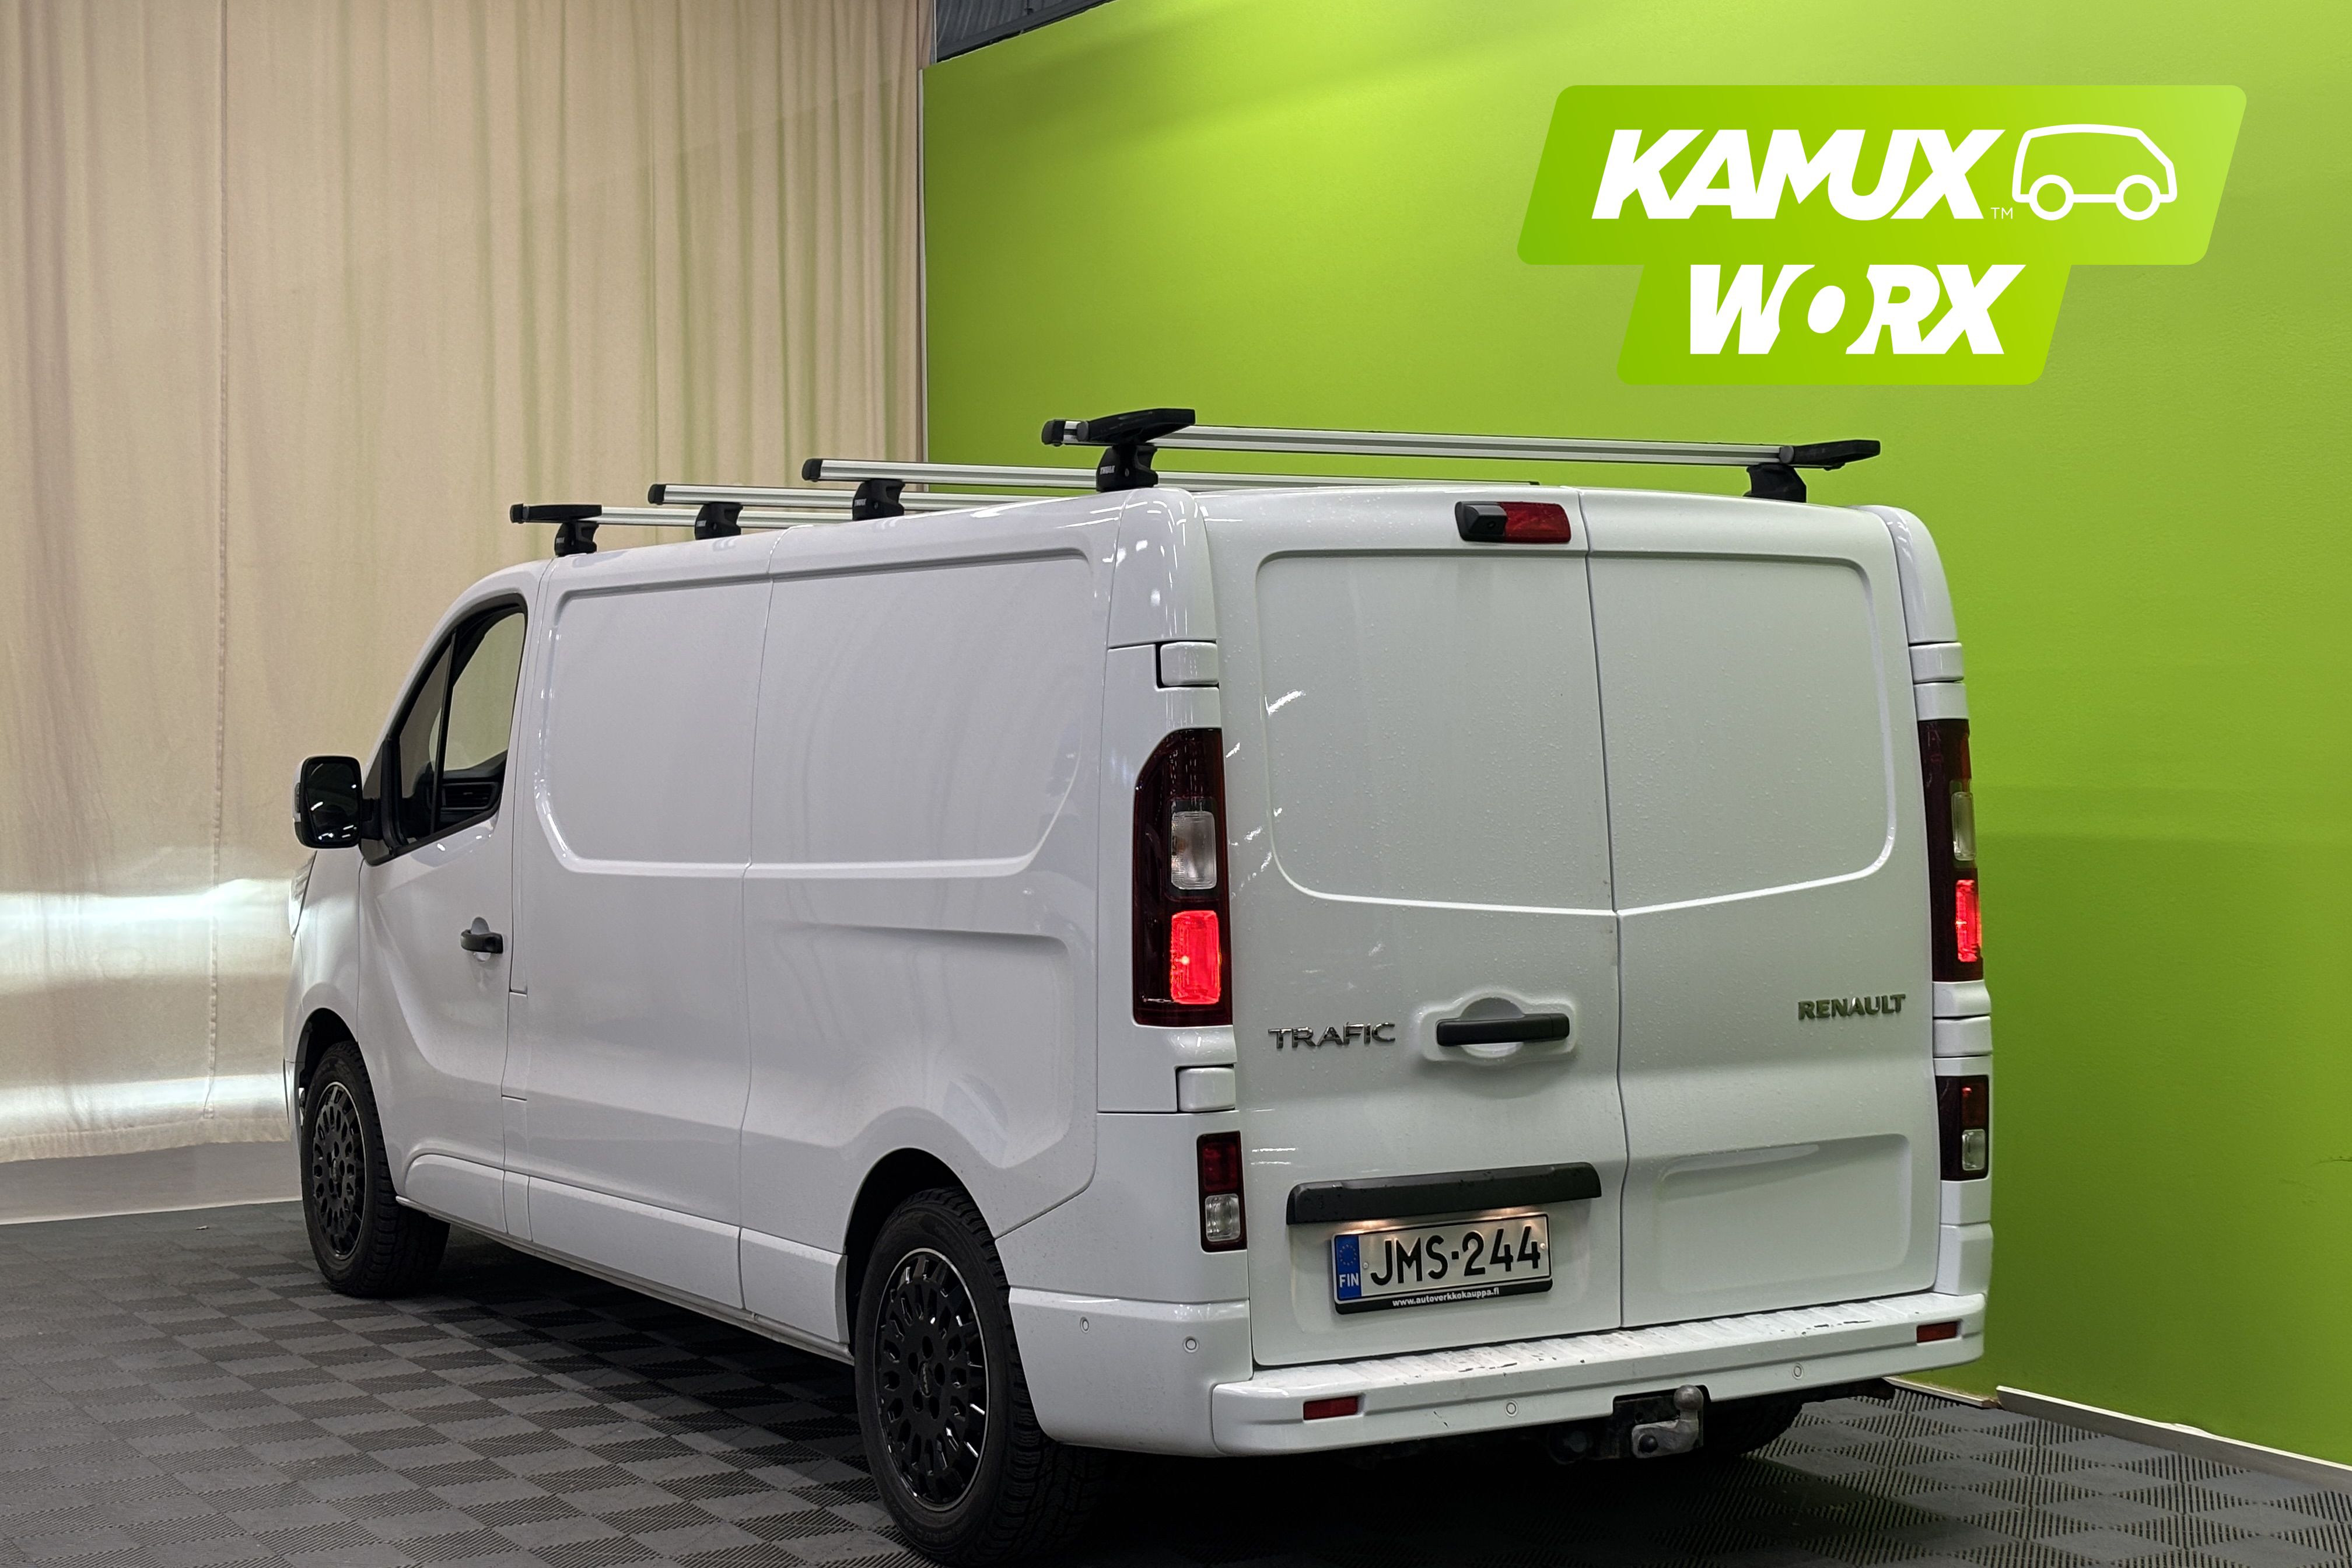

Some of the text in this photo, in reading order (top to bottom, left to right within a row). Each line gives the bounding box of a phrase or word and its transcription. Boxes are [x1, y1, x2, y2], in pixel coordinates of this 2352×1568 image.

[1798, 994, 1906, 1021] RENAULT
[1268, 1021, 1396, 1049] TRAFIC
[1370, 1226, 1541, 1286] JMS-244
[1339, 1272, 1359, 1288] FIN
[1392, 1287, 1500, 1307] www.autoverkkokauppa.fi
